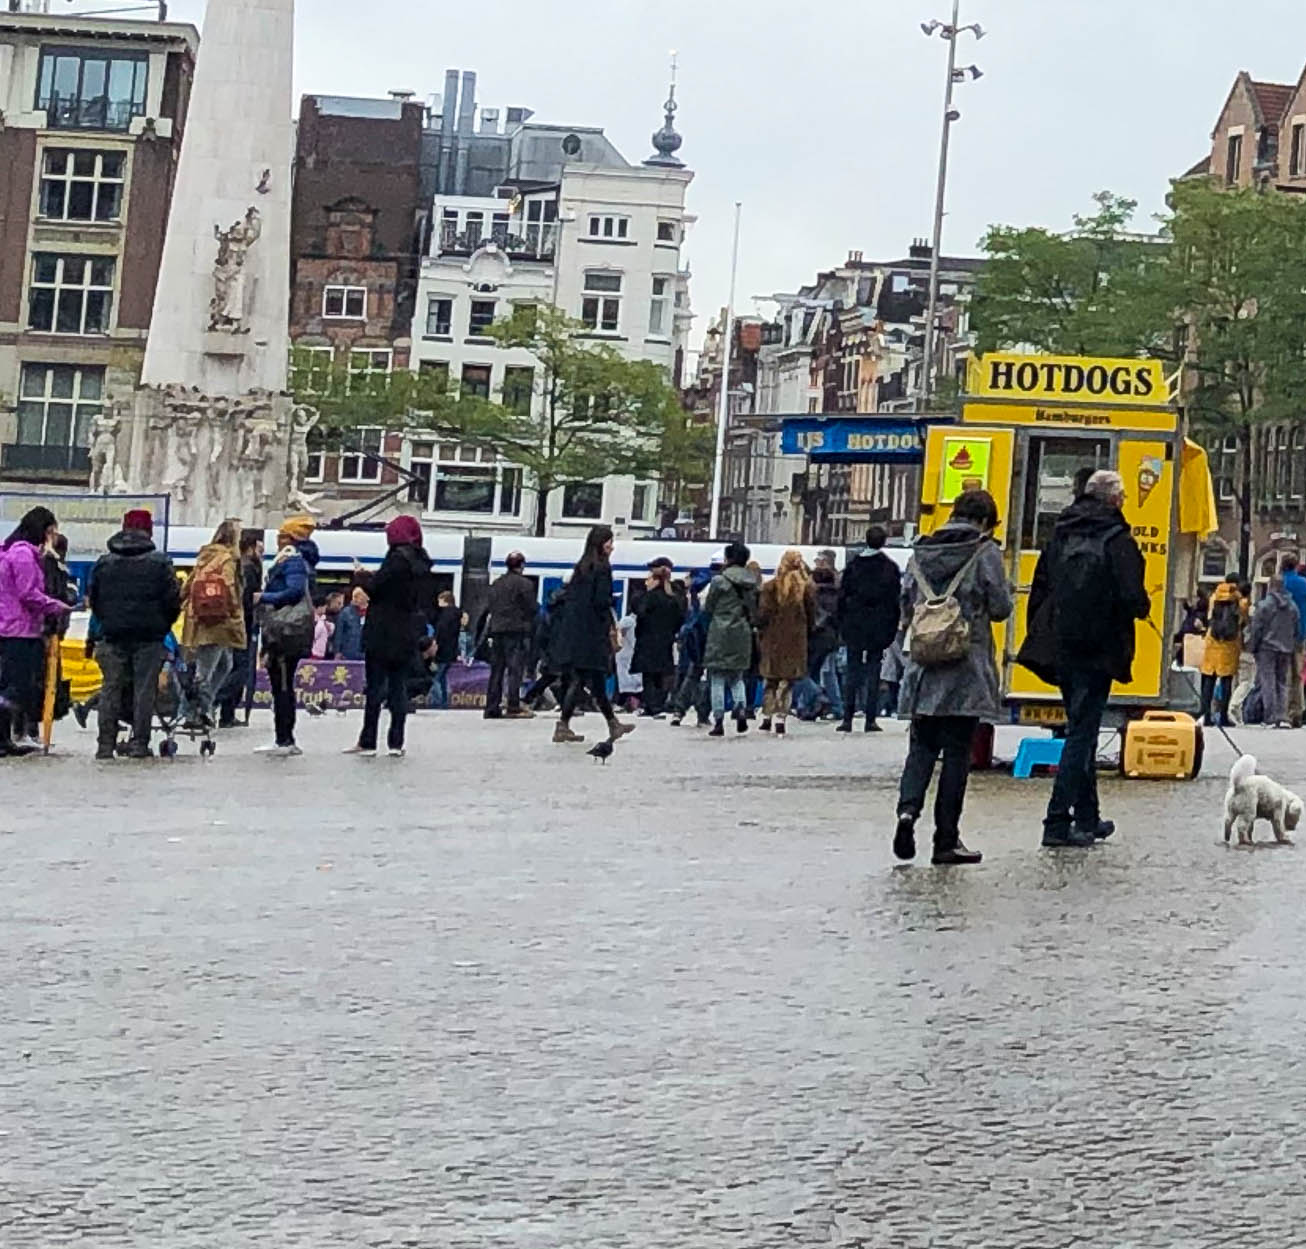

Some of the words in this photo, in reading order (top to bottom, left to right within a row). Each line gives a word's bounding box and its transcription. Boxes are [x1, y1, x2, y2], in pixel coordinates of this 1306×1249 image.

[988, 360, 1154, 397] HOTDOGS
[1034, 407, 1112, 426] Hamburgers
[1131, 525, 1160, 539] OLD
